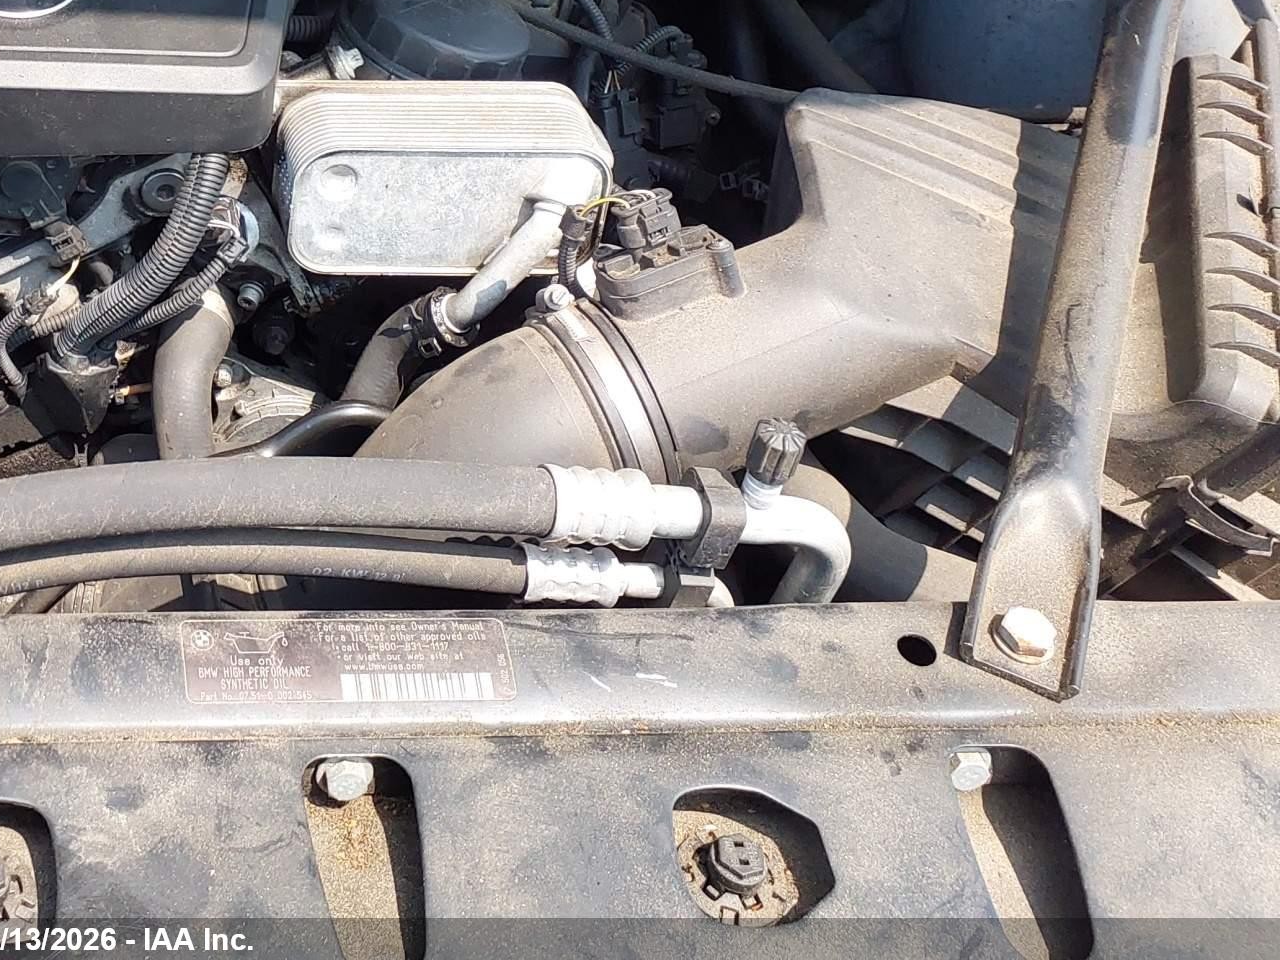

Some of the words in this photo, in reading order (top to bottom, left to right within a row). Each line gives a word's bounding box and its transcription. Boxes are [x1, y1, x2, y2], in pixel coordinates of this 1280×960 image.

[316, 622, 332, 632] For
[338, 624, 360, 632] more
[366, 622, 385, 632] info
[411, 621, 447, 632] Owner's
[451, 621, 484, 631] Manual
[318, 632, 334, 642] For
[350, 631, 368, 642] list
[374, 632, 385, 642] of
[390, 631, 417, 641] other
[420, 632, 463, 644] approved
[467, 631, 487, 641] oils
[341, 642, 360, 652] call
[359, 652, 380, 661] visit
[386, 653, 401, 661] our
[430, 652, 449, 661] site
[454, 651, 464, 660] at
[230, 655, 251, 666] Use
[258, 655, 284, 669] only
[344, 662, 425, 672] www.bmwusa.com
[198, 667, 218, 679] BMW
[223, 666, 244, 678] HIGH
[249, 666, 312, 678] PERFORMANCE
[221, 678, 268, 690] SYNTHETIC
[274, 678, 289, 690] OIL
[200, 691, 217, 701] Part
